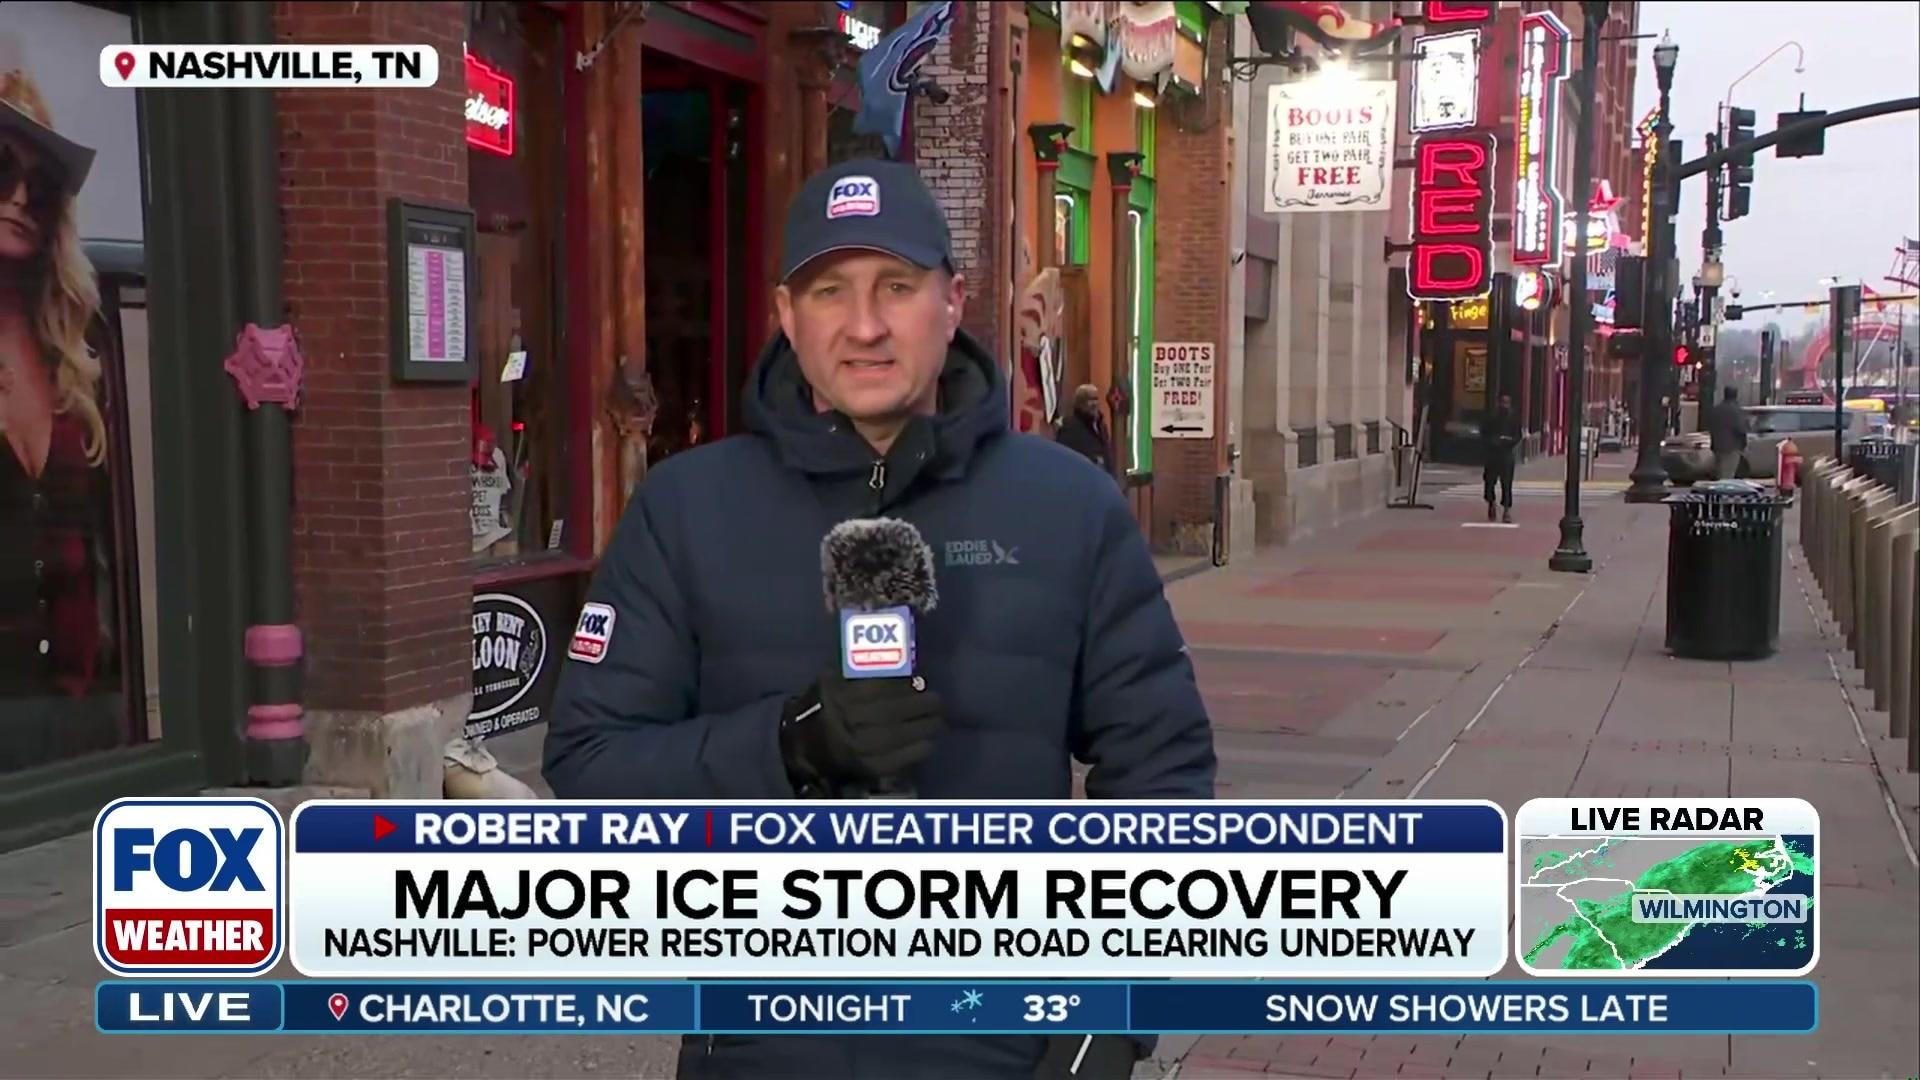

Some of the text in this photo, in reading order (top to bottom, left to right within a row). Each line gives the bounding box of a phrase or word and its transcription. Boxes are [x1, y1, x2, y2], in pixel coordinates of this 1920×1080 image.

[1288, 105, 1373, 127] BOOTS
[1287, 148, 1373, 165] GET TWO PAIR
[1298, 166, 1362, 186] FREE
[833, 183, 873, 201] FOX
[1417, 142, 1485, 289] RED
[1155, 347, 1211, 361] BOOTS
[1171, 376, 1191, 388] TWO
[1163, 391, 1203, 406] FREE!
[579, 612, 609, 636] FOX
[853, 624, 899, 645] FOX
[500, 706, 540, 728] OPERATED
